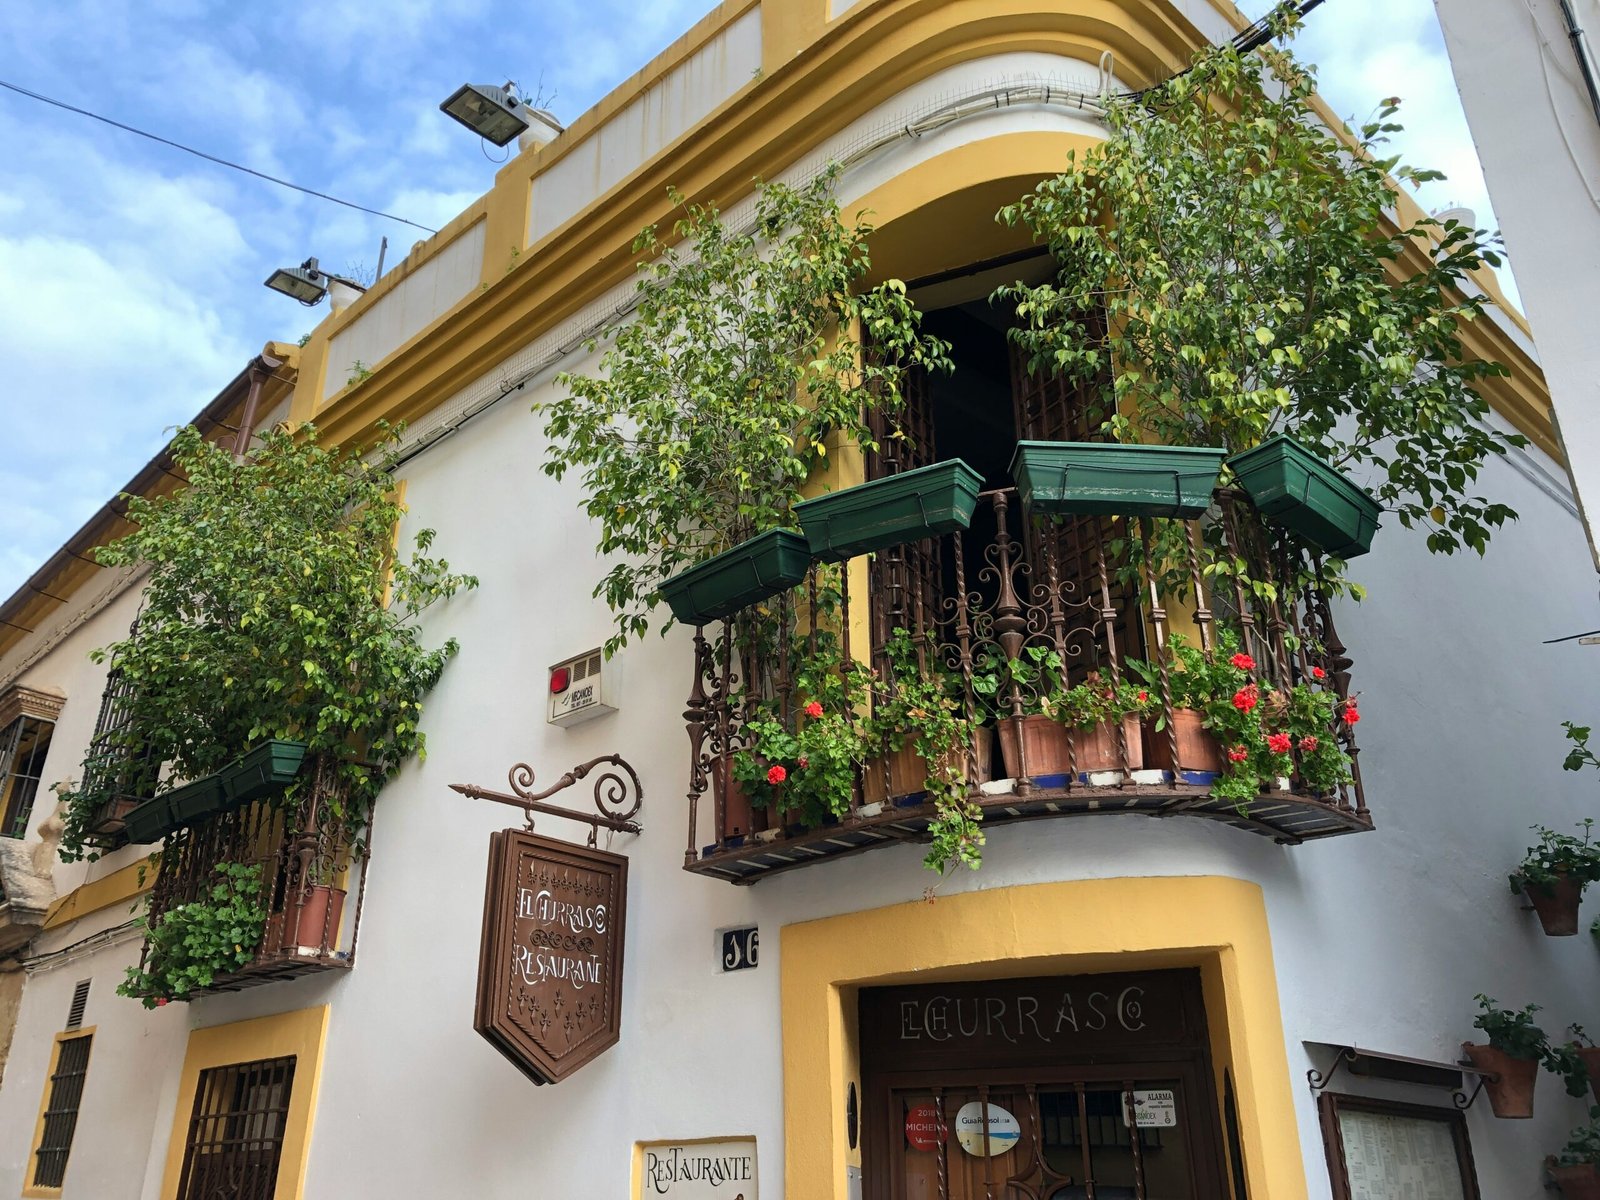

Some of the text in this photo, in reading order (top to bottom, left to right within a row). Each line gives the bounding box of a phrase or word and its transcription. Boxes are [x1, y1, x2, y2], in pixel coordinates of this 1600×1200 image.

[519, 888, 534, 920] EL
[514, 945, 602, 990] RESTAURANTE
[900, 986, 1146, 1044] EL CHURRASCO
[1148, 1093, 1173, 1101] ALARMA
[647, 1148, 752, 1194] RESTAURANTE
